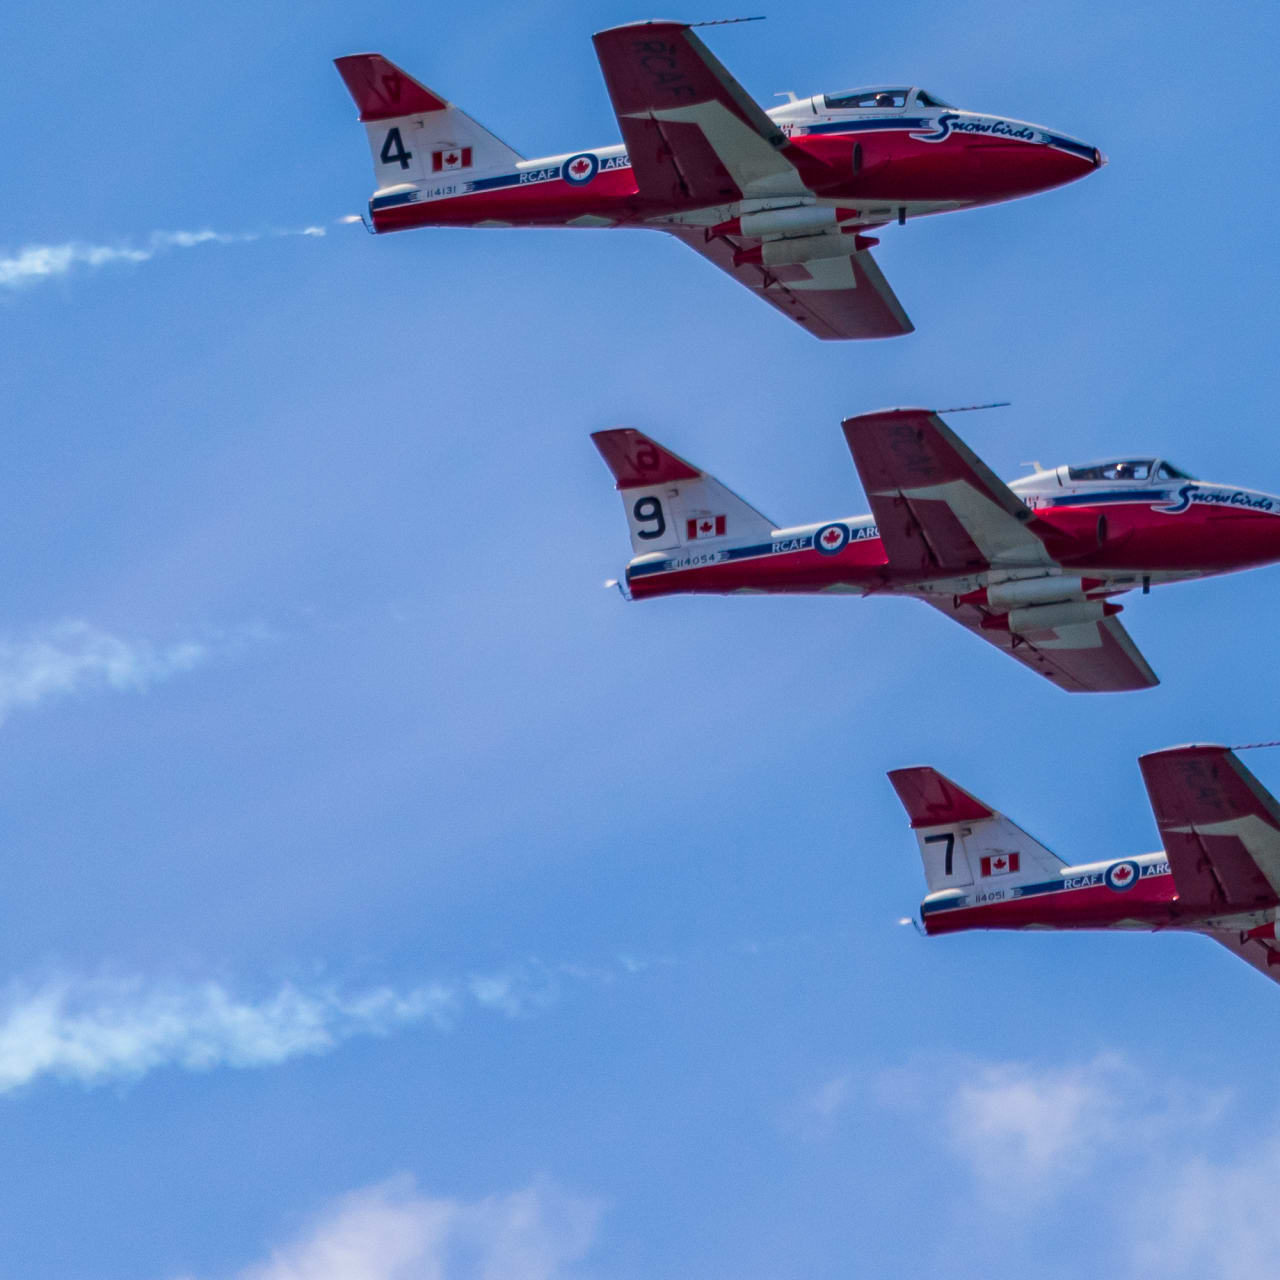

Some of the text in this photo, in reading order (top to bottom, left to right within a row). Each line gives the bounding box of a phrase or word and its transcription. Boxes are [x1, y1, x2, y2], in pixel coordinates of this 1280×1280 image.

[911, 114, 1035, 142] Snowbirds
[379, 126, 413, 170] 4
[519, 169, 555, 184] RCAF
[426, 185, 456, 198] 114131
[1152, 485, 1274, 513] Snowbirds
[633, 496, 666, 540] 9
[772, 538, 807, 553] RCAF
[924, 833, 955, 876] 7
[1064, 875, 1097, 890] RCAF
[976, 890, 1005, 903] 114051
